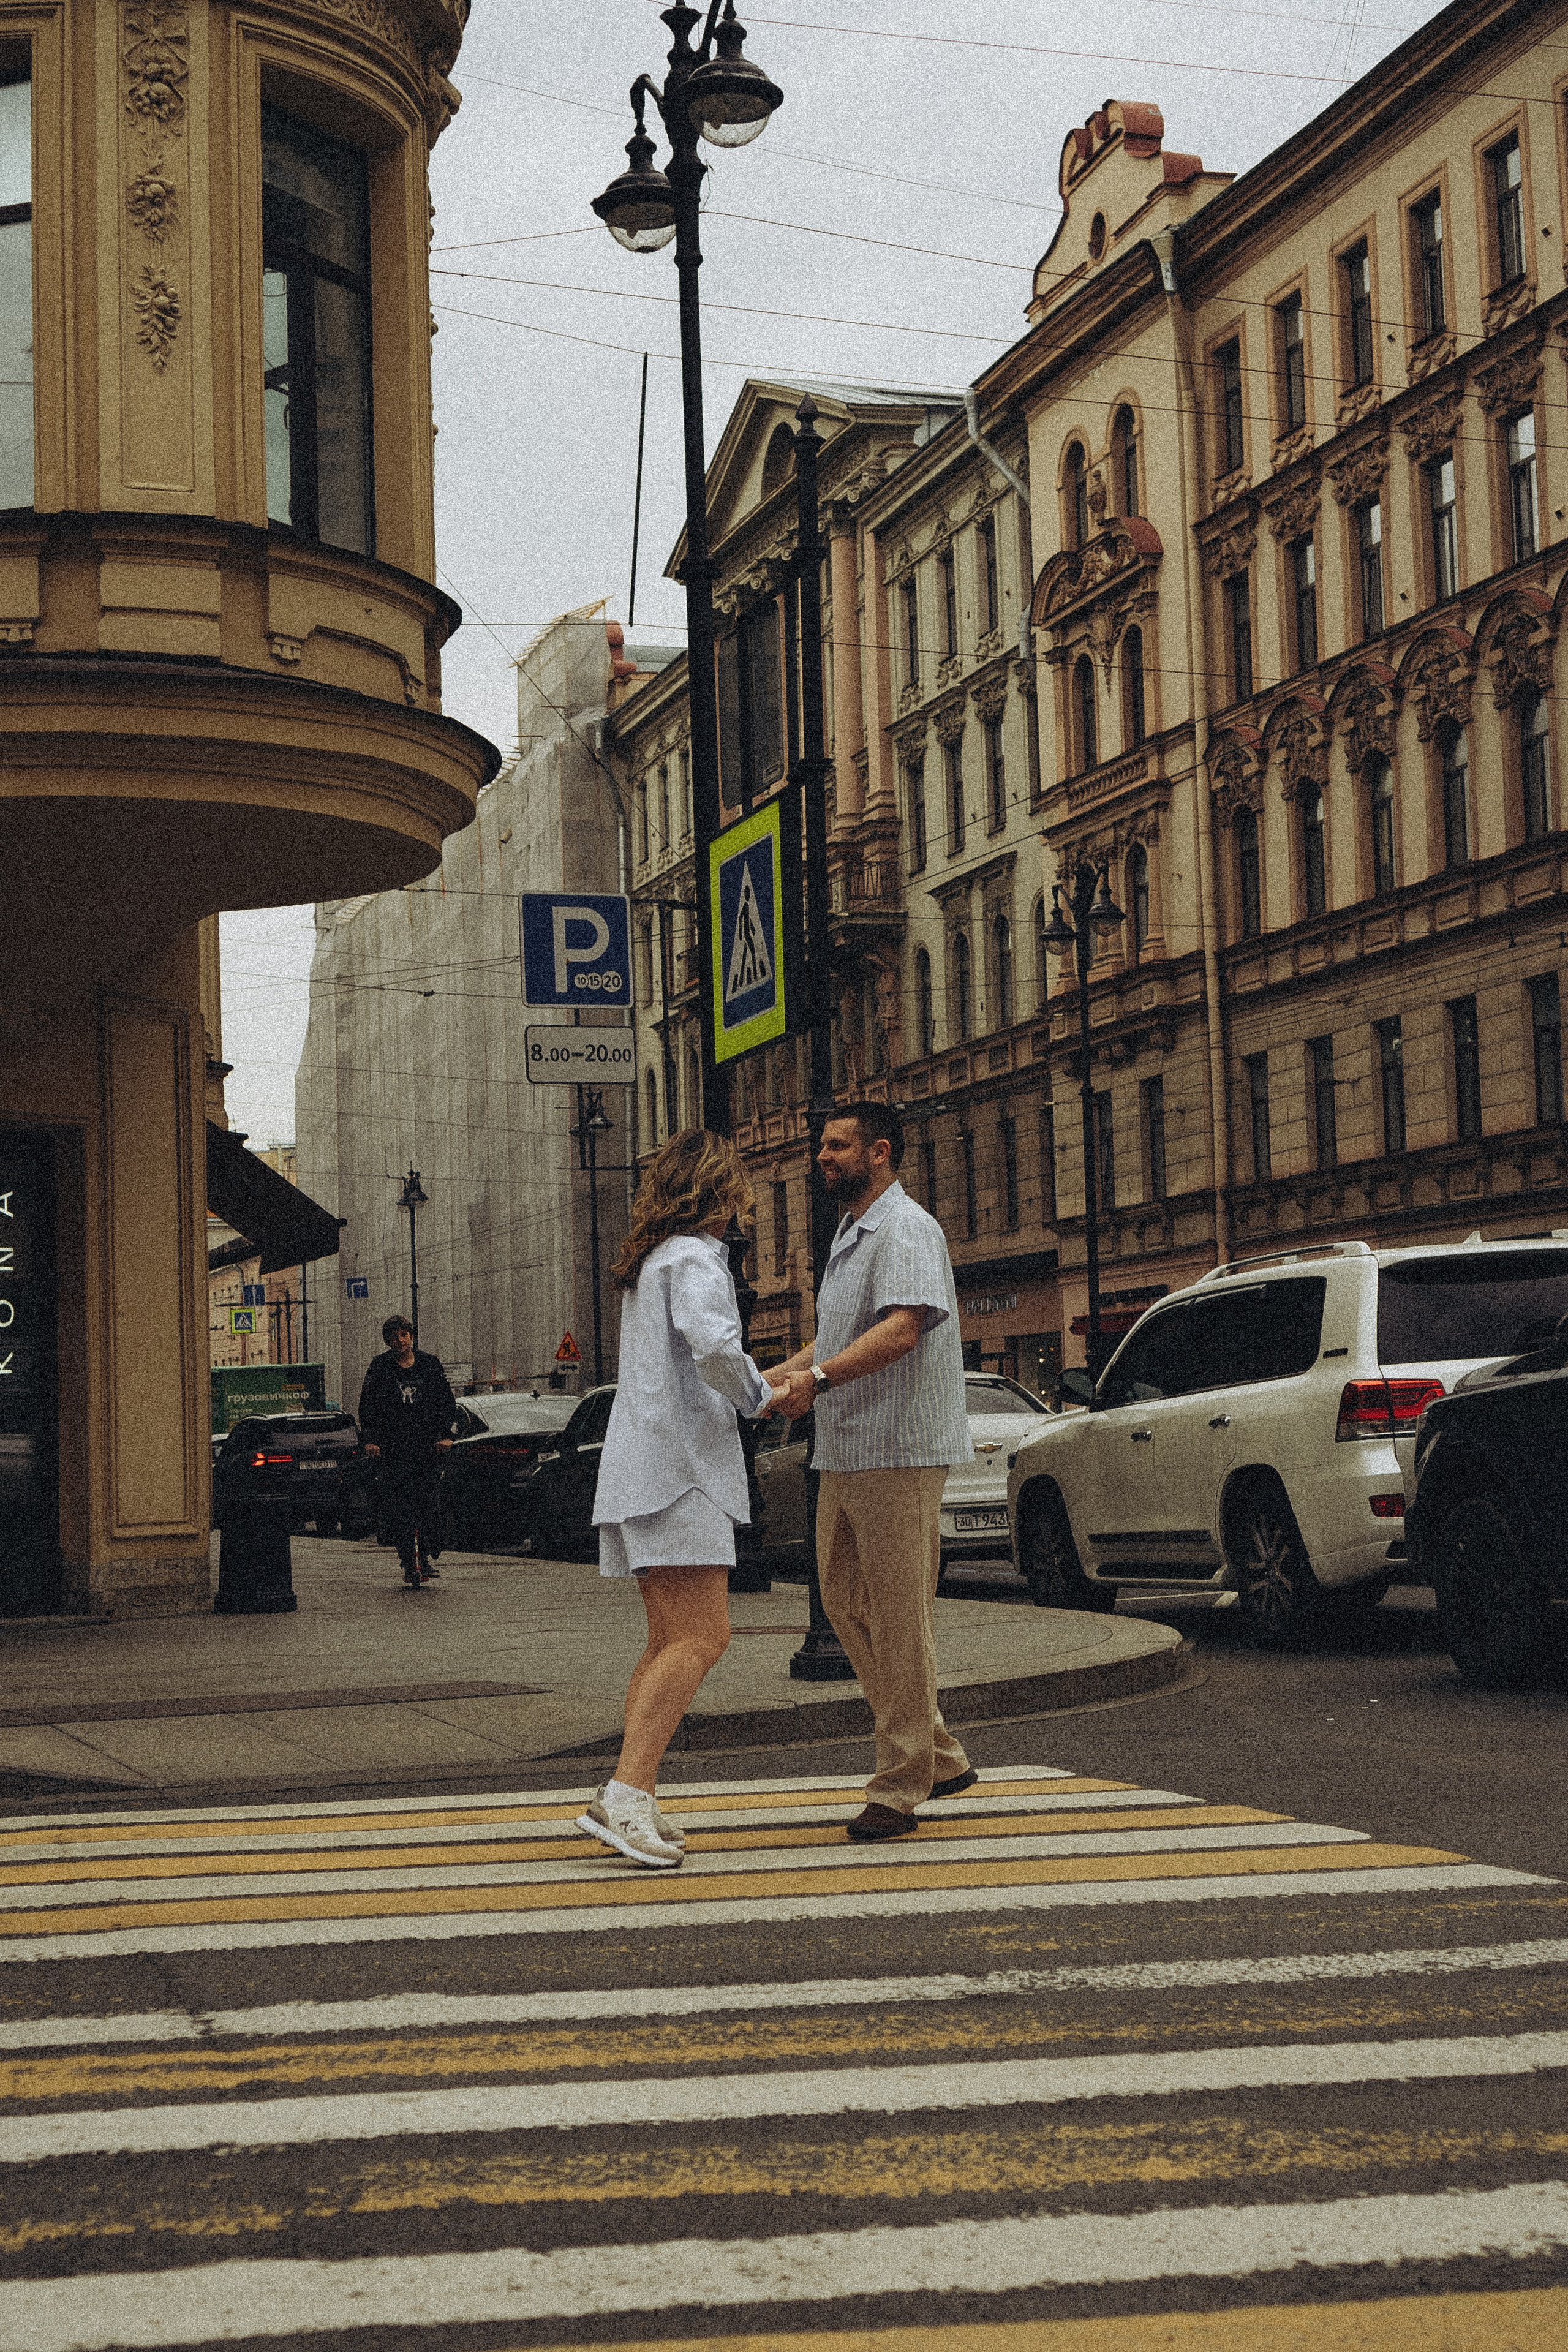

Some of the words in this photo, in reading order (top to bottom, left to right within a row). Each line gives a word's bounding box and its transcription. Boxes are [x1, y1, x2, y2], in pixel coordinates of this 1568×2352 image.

[552, 907, 609, 993] P
[577, 976, 586, 986] 10
[589, 976, 600, 987] 15
[604, 974, 620, 988] 20
[982, 1512, 1008, 1526] 943
